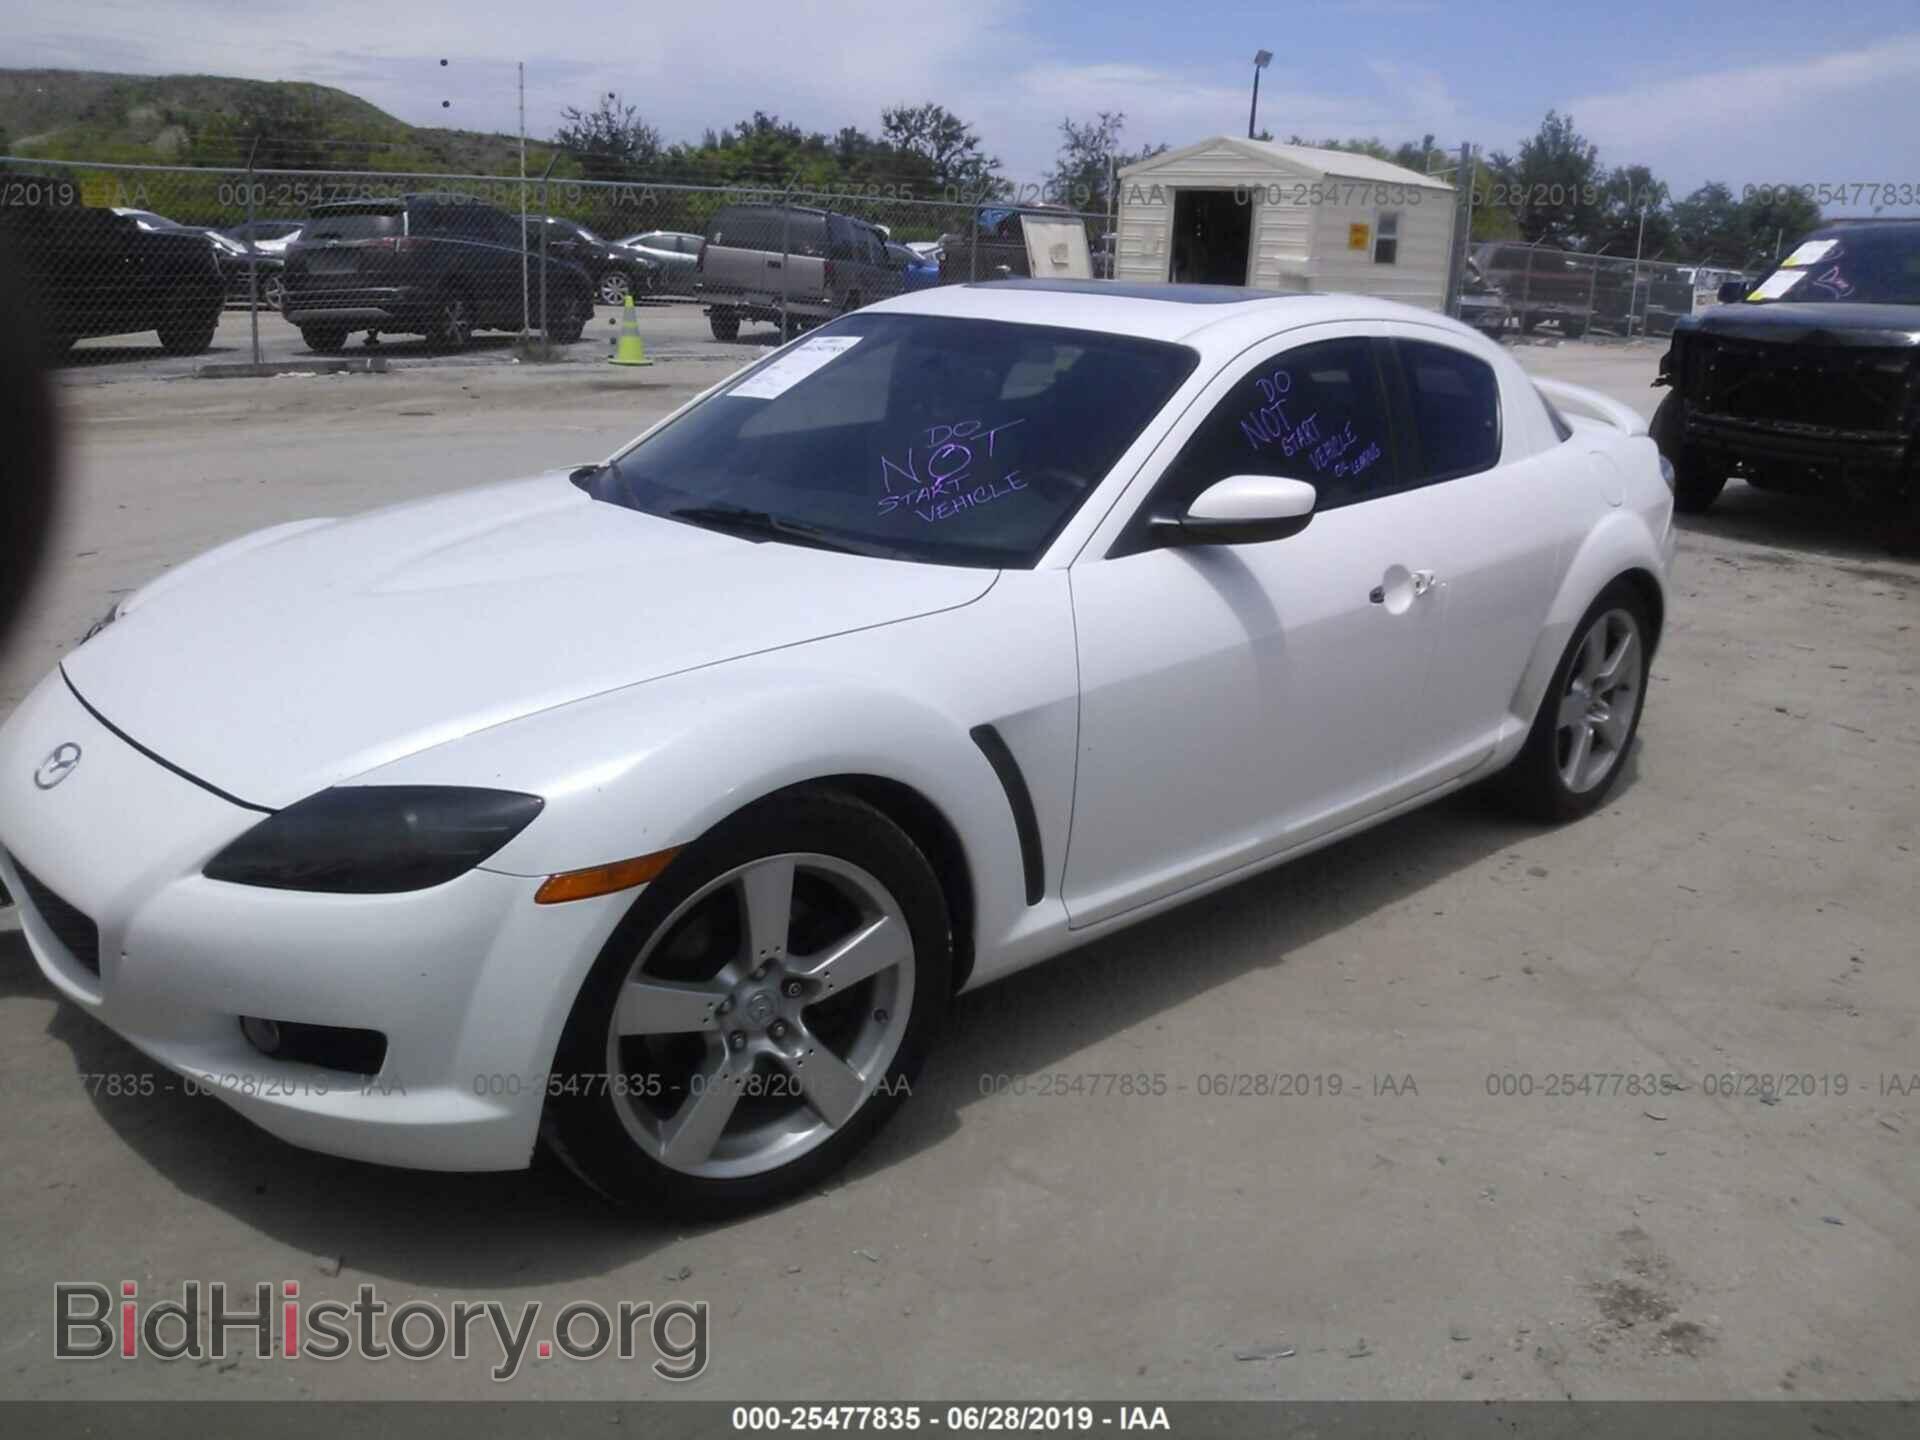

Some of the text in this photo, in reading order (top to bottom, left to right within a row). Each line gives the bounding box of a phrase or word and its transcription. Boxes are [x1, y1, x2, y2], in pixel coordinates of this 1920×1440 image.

[1256, 371, 1291, 402] DO
[924, 420, 982, 449] DO
[1240, 399, 1291, 450] NOT
[881, 418, 1026, 493] NOT
[877, 473, 971, 517] START
[914, 470, 1029, 523] VEHICLE
